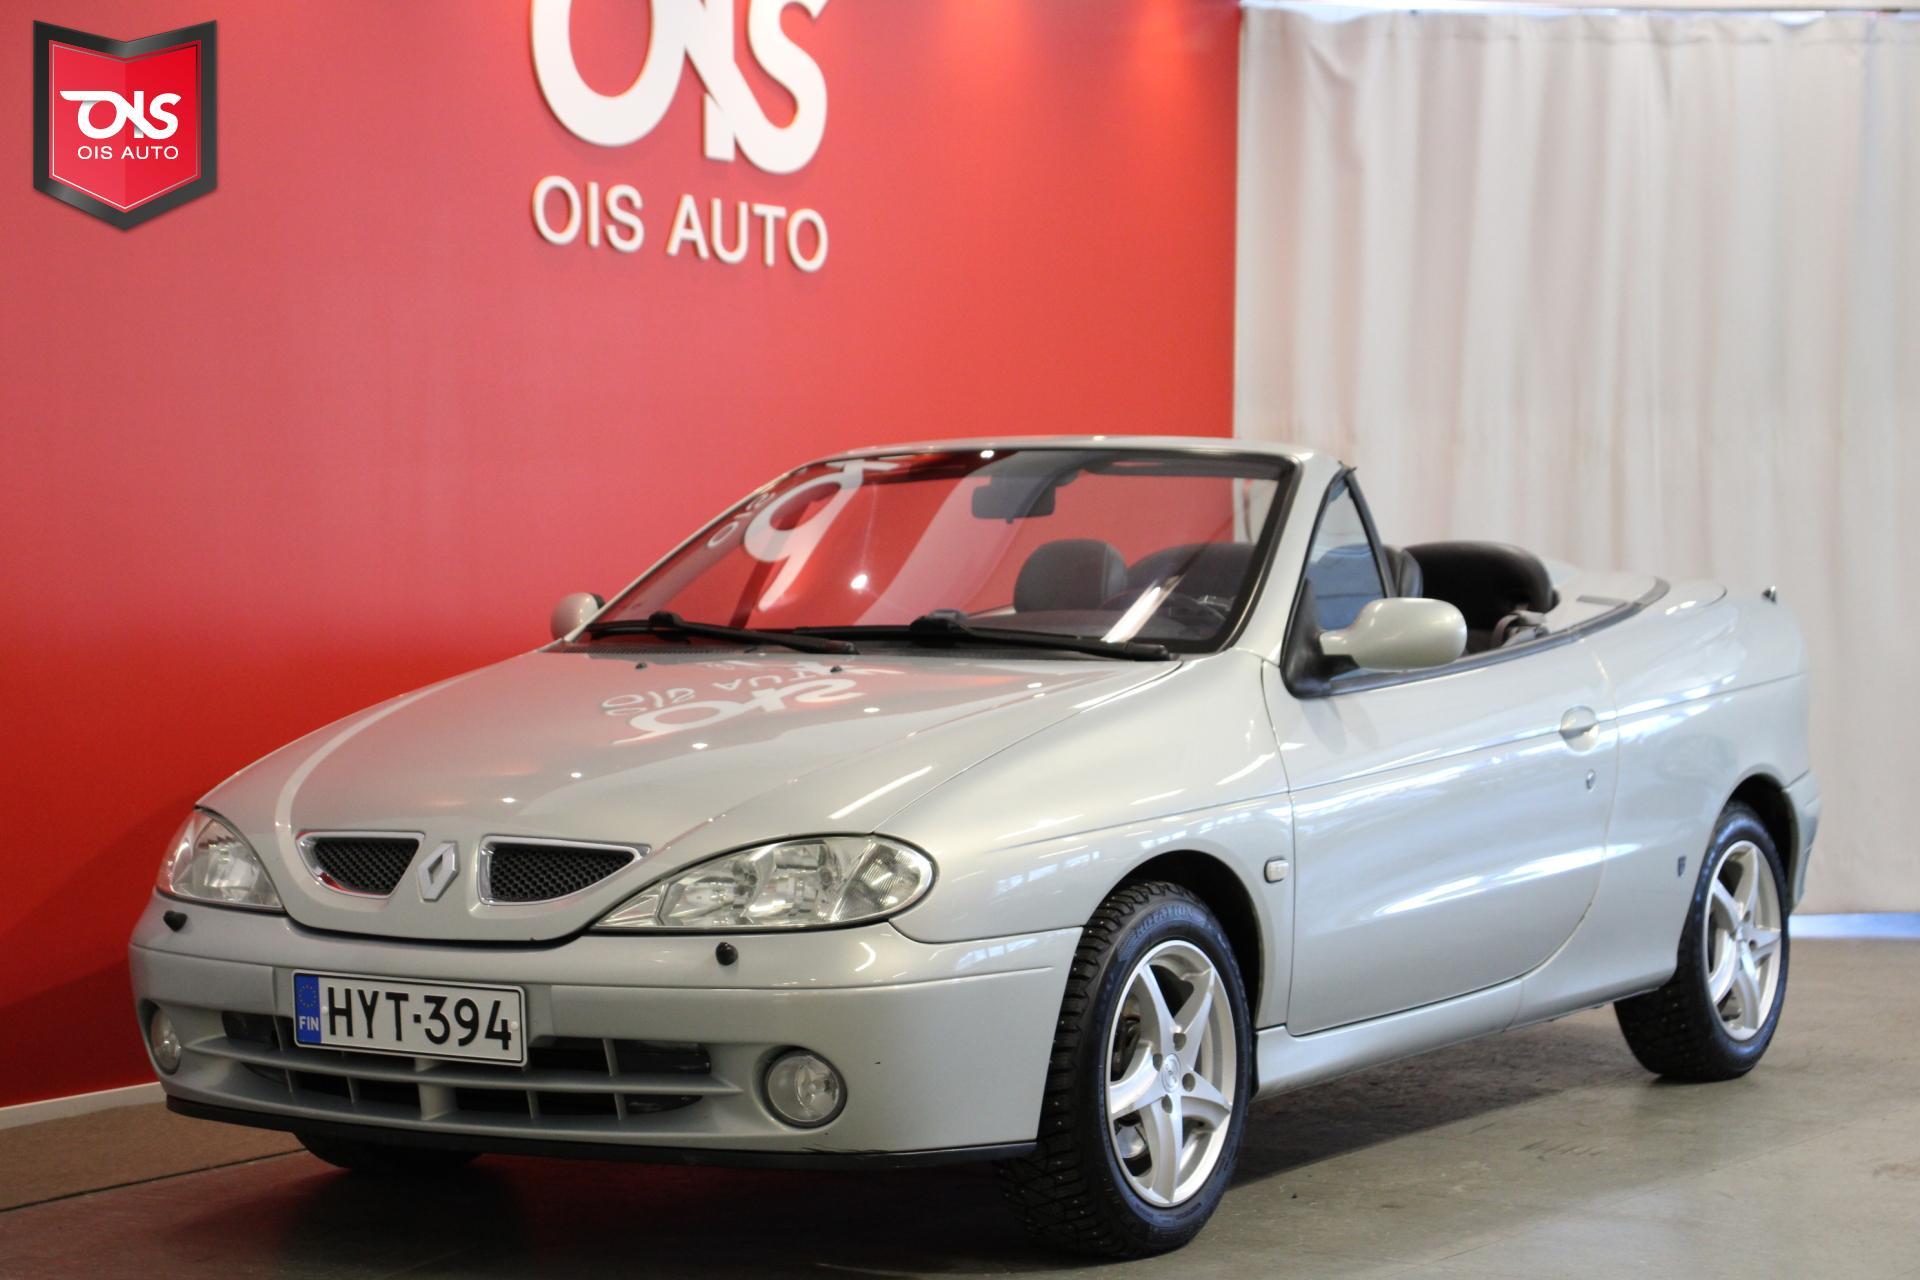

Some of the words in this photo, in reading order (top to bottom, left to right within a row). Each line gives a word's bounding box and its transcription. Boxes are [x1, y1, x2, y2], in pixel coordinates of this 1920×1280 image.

[532, 175, 645, 253] OIS
[666, 193, 829, 273] AUTO
[299, 1015, 320, 1032] FIN
